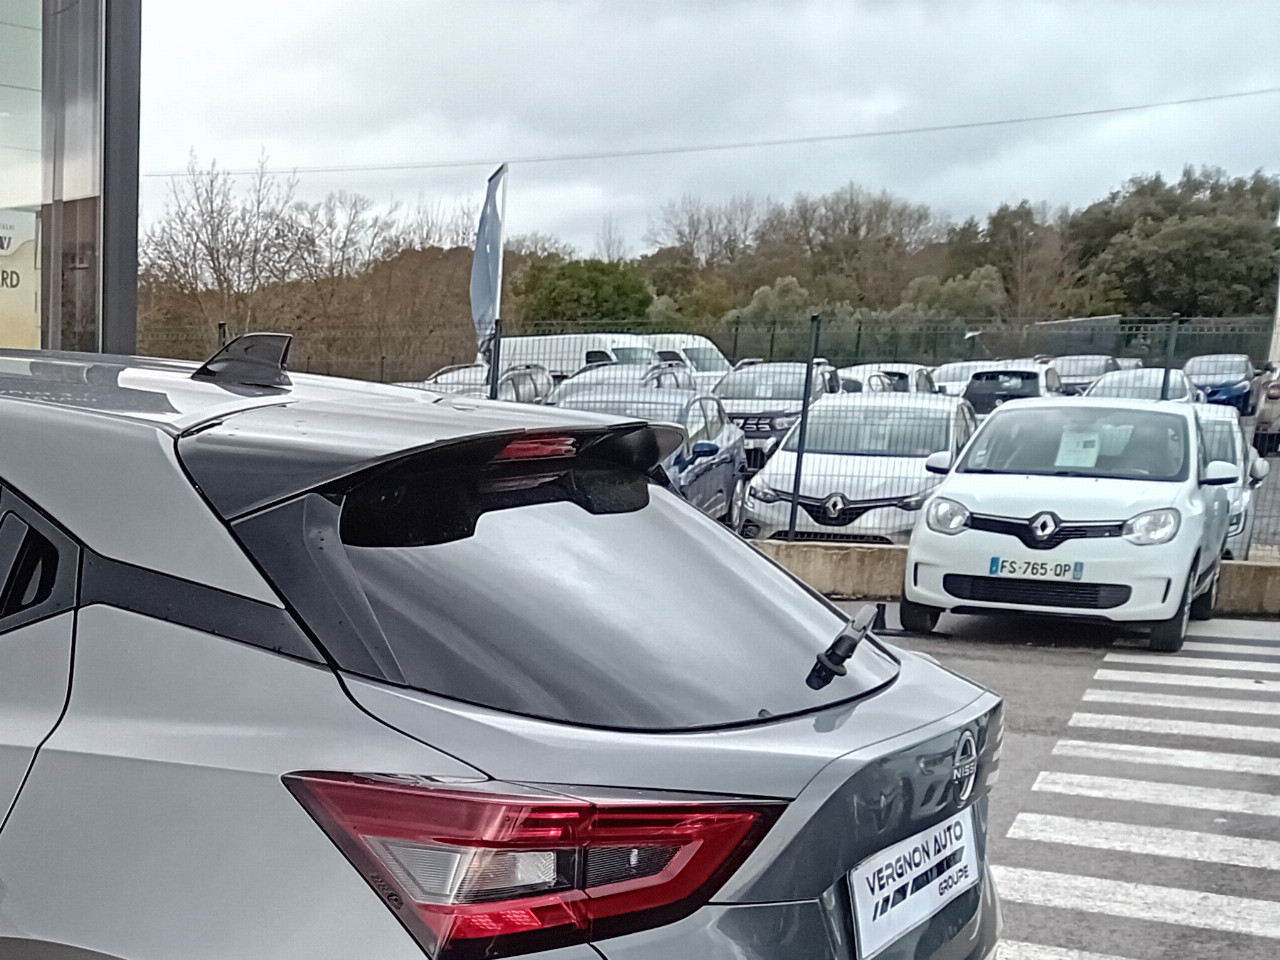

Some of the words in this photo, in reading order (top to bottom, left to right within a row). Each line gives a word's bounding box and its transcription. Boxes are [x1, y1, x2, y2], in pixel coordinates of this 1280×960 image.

[865, 840, 931, 896] VERGNON
[933, 820, 964, 857] AUTO
[938, 864, 970, 897] GROUPE
